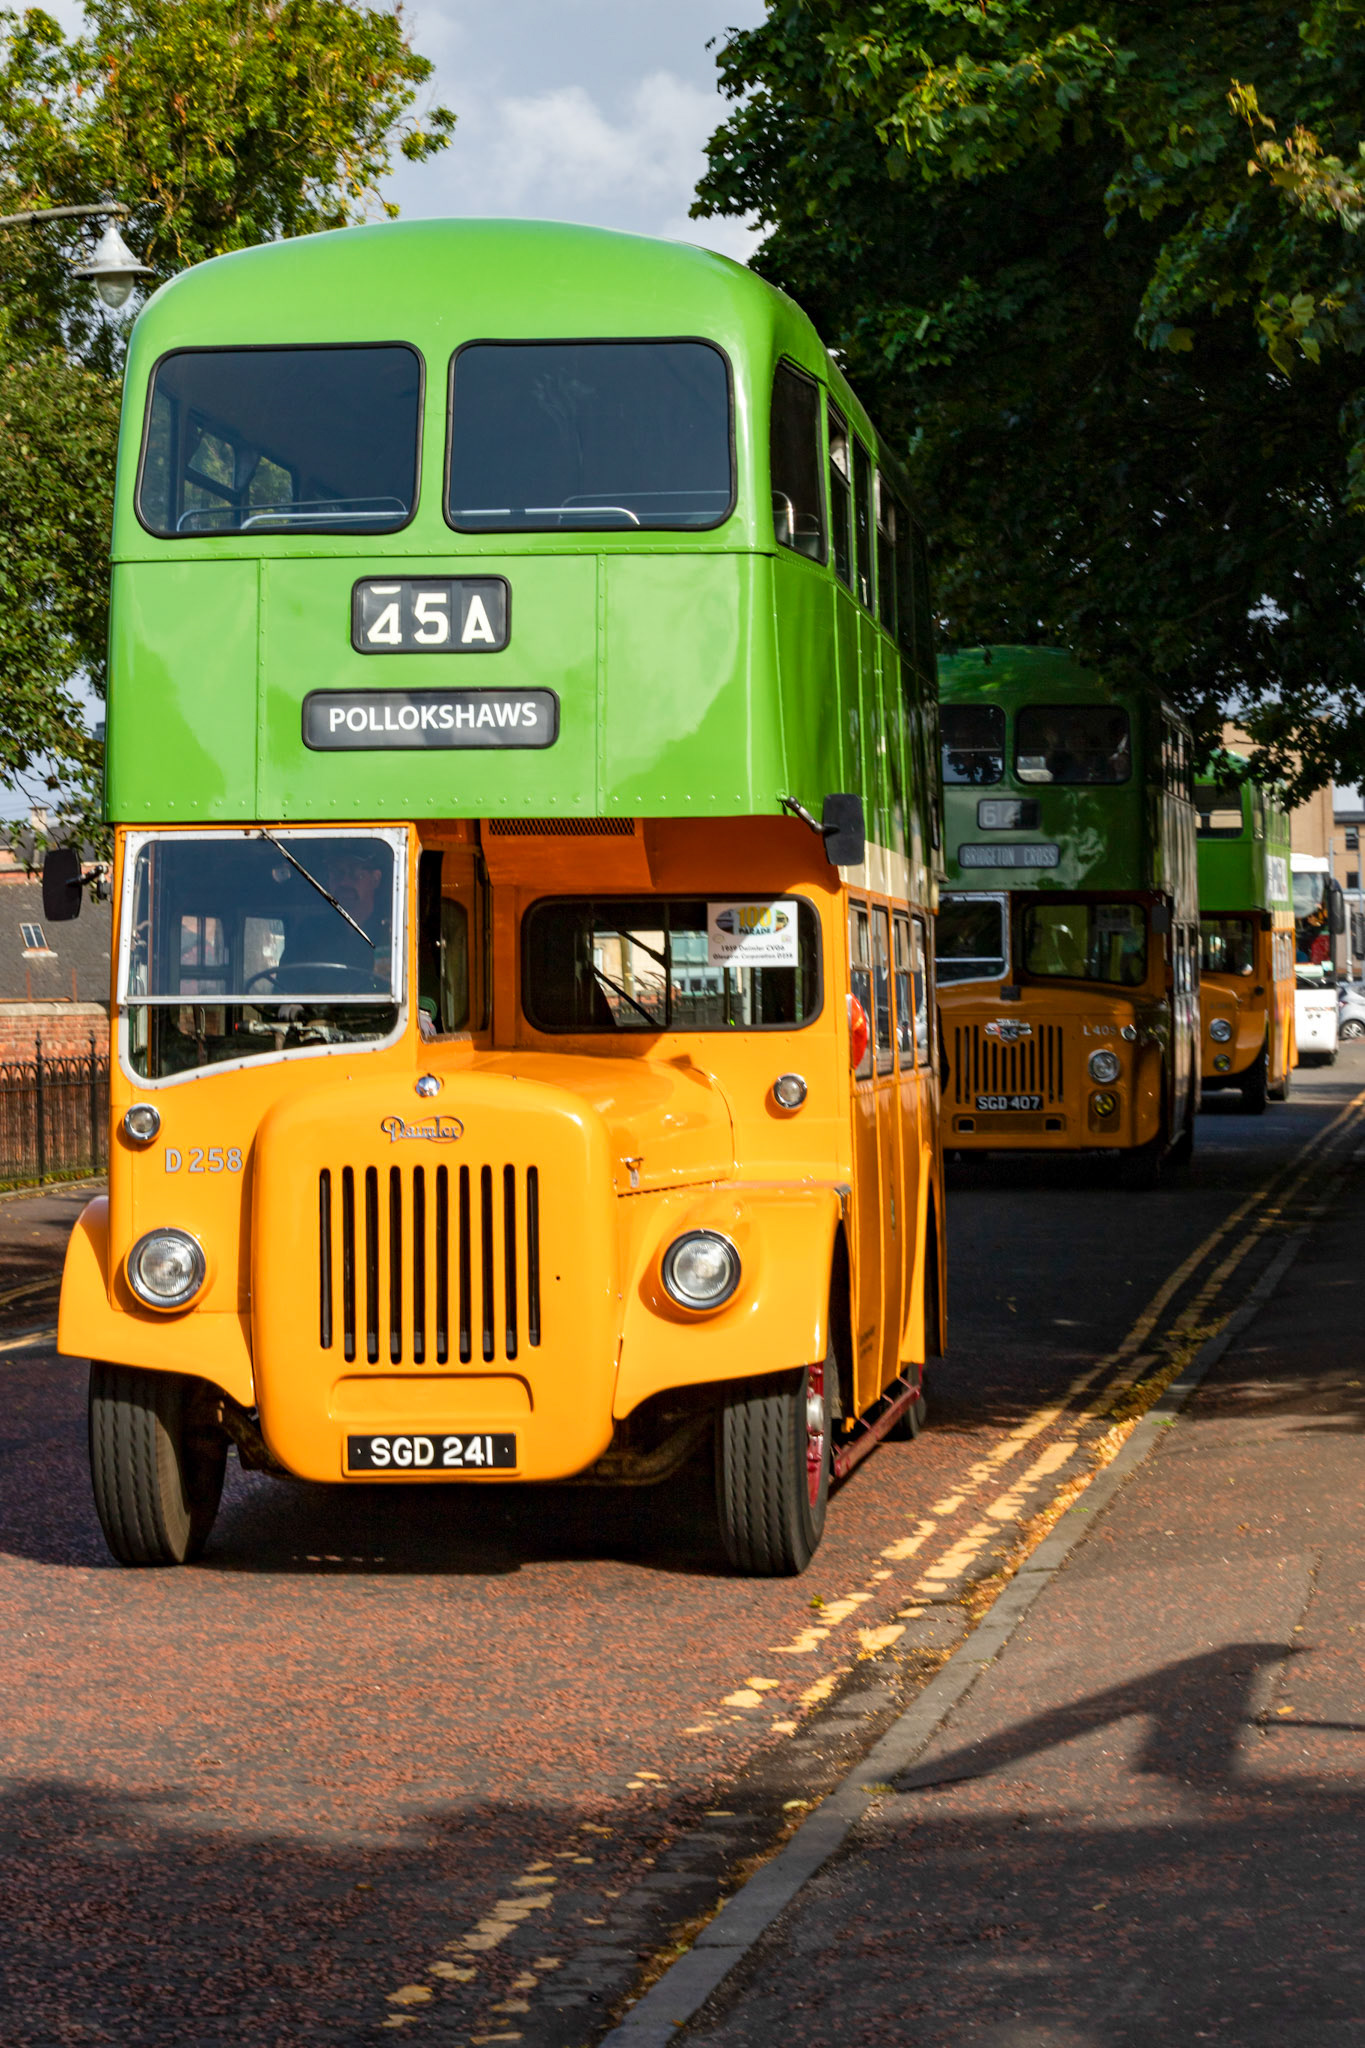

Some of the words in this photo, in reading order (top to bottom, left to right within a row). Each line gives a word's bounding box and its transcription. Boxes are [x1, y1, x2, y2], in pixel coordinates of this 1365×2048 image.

[367, 593, 495, 645] 45A
[329, 702, 538, 733] POLLOKSHAWS
[964, 847, 1015, 866] BRIDGETON
[1024, 847, 1056, 866] CROSS
[737, 905, 772, 928] 100
[1083, 1025, 1091, 1036] L
[1092, 1025, 1117, 1036] 405
[978, 1096, 1008, 1110] SGD
[1010, 1096, 1040, 1110] 407
[380, 1116, 464, 1144] Daimler
[165, 1148, 182, 1173] D
[189, 1147, 243, 1173] 258
[370, 1437, 434, 1466] SGD
[443, 1436, 493, 1466] 241
